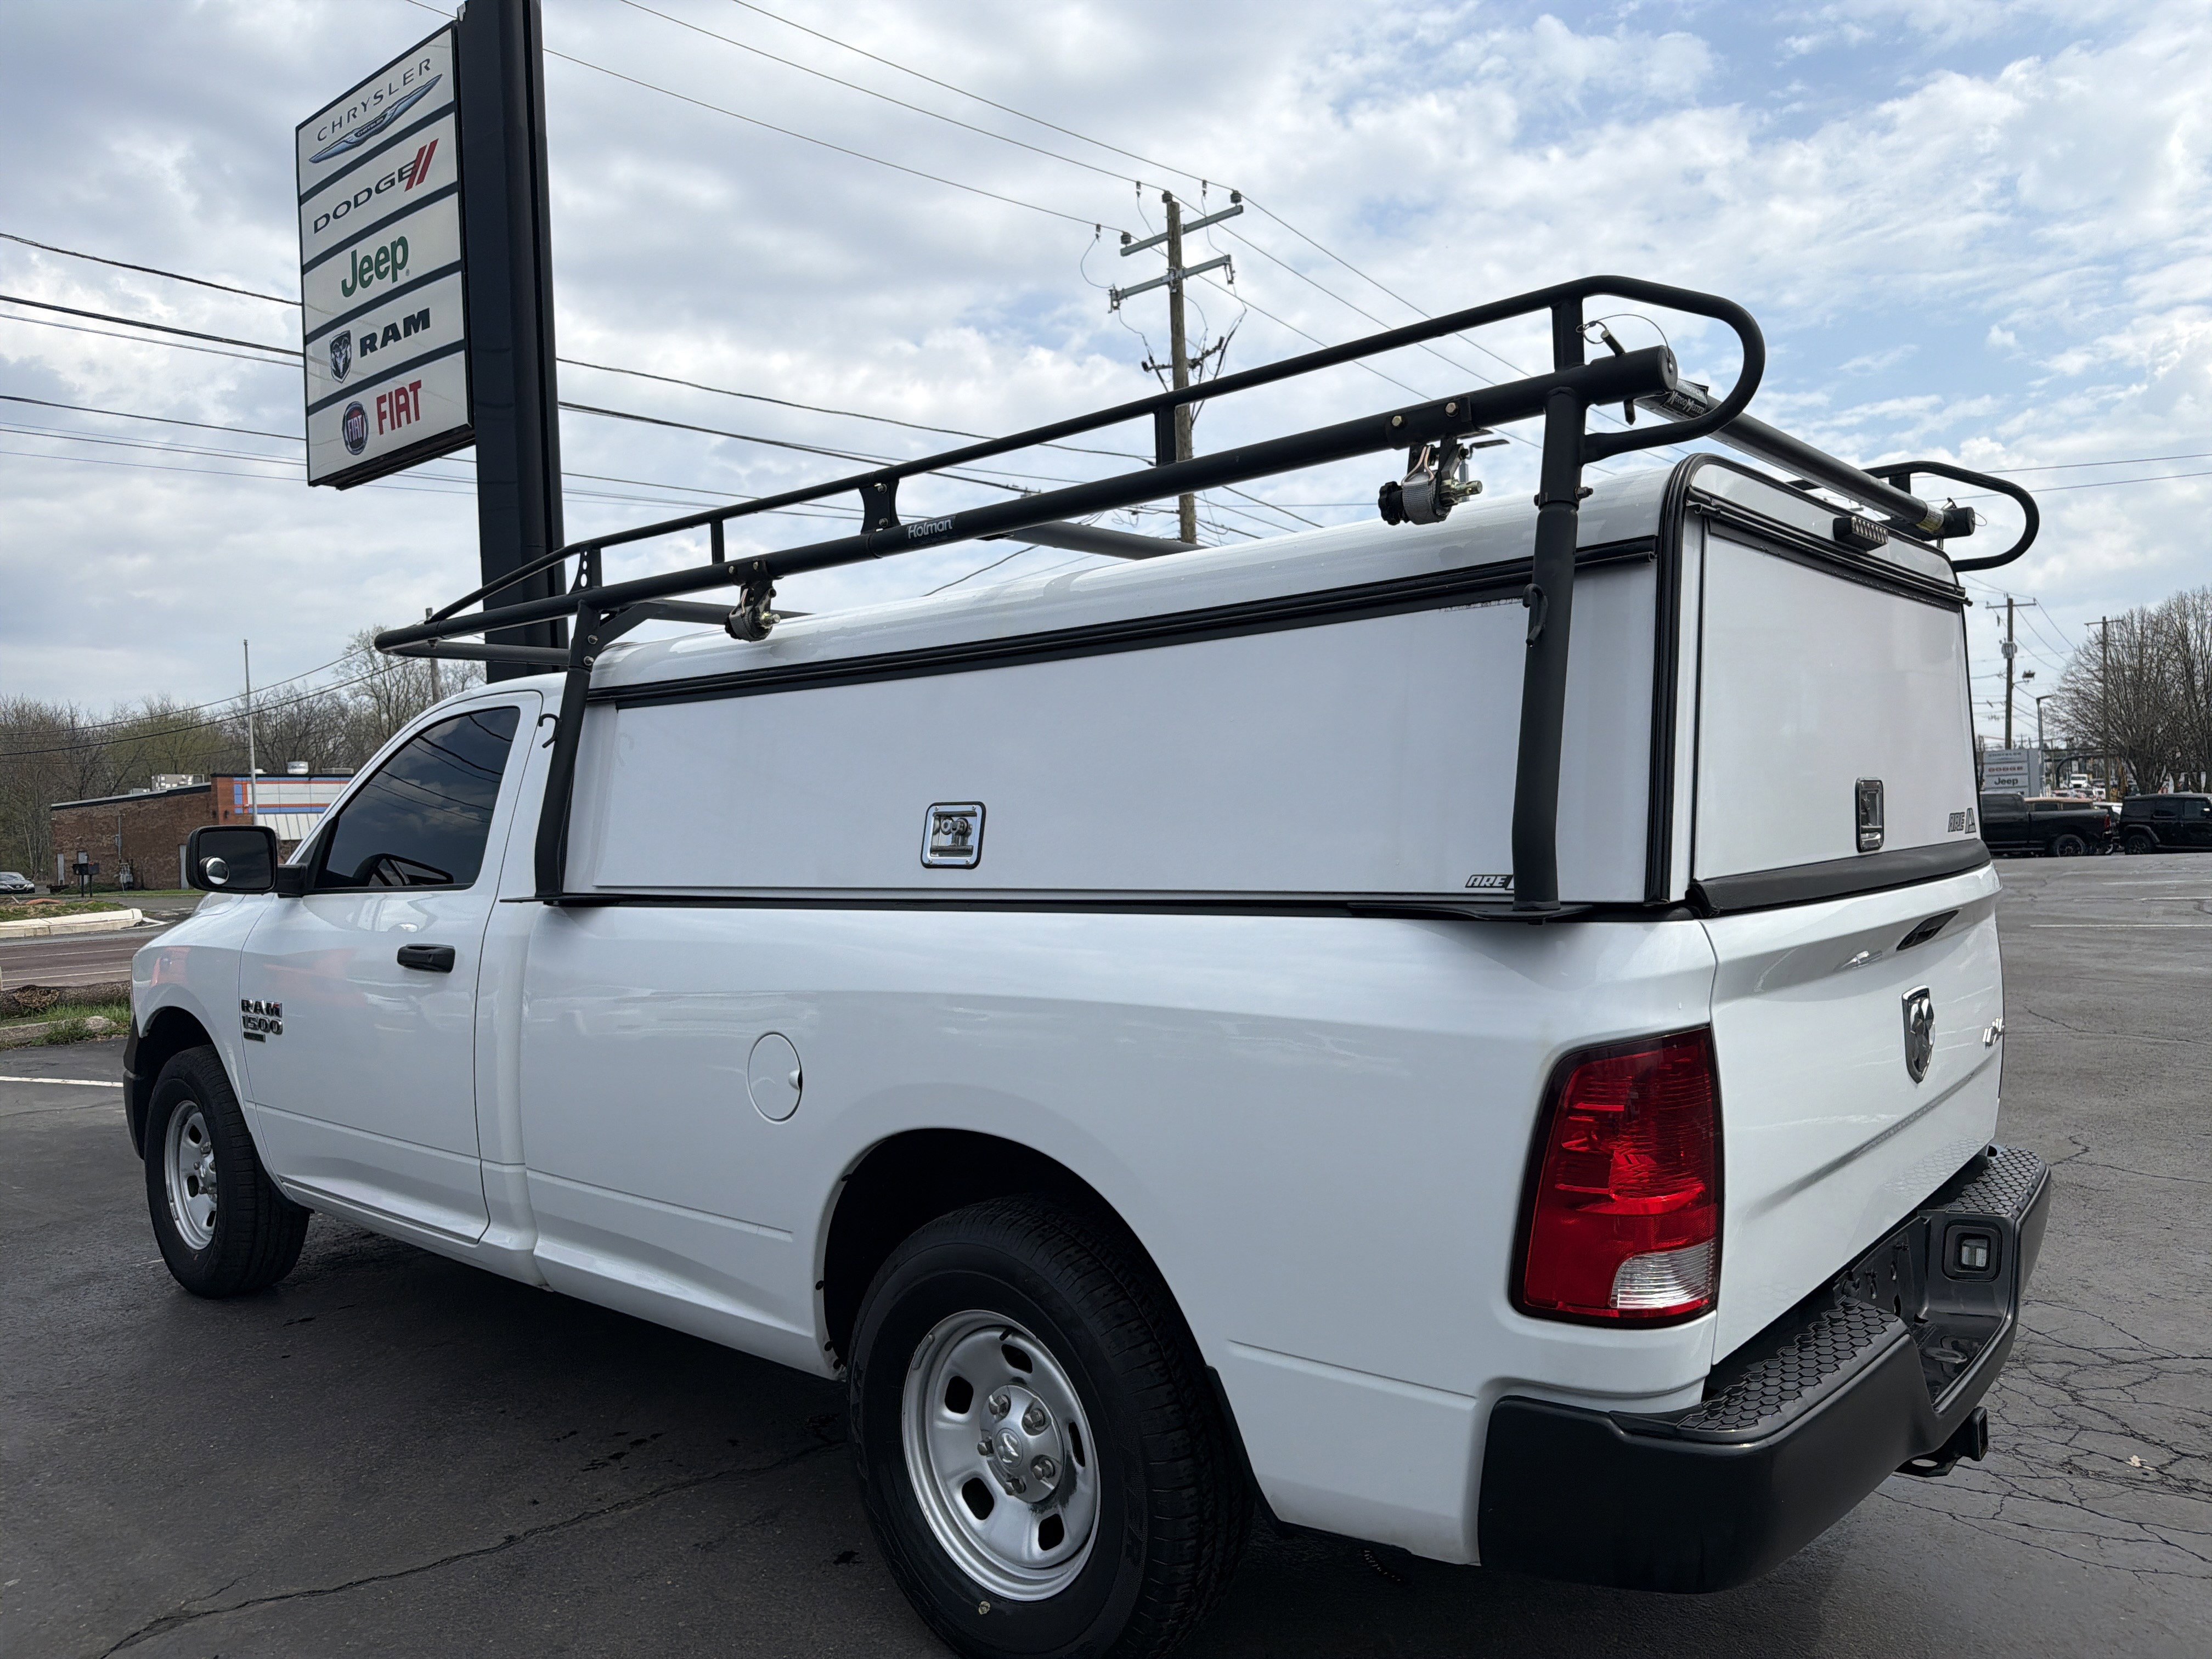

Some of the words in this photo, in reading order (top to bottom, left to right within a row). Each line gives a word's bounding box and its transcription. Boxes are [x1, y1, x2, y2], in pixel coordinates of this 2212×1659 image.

[317, 58, 431, 142] CHRYSLER
[314, 159, 418, 234] DODGE
[341, 236, 409, 298] Jeep
[359, 307, 431, 358] RAM
[376, 379, 422, 436] FIAT
[347, 414, 363, 443] FIAT
[908, 519, 953, 539] Holman
[1994, 777, 2018, 786] Jeep
[1465, 874, 1508, 888] ARE
[241, 998, 283, 1018] RAM
[242, 1014, 283, 1035] 1500
